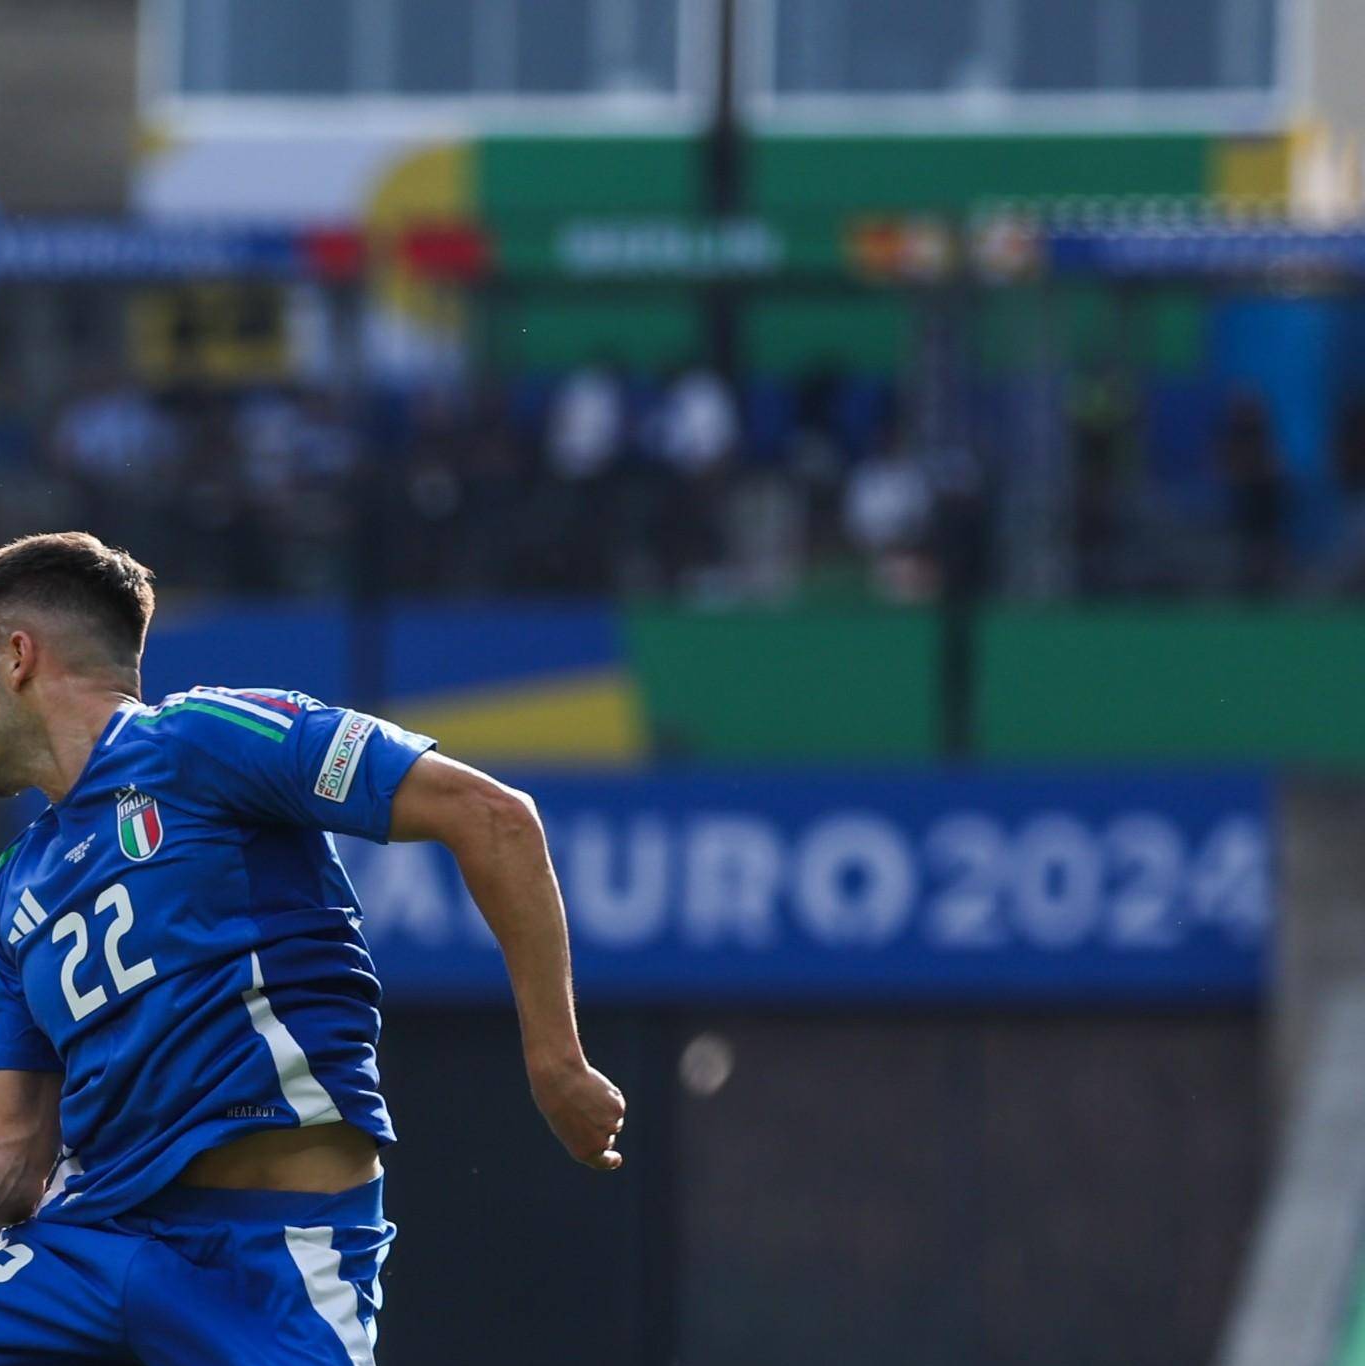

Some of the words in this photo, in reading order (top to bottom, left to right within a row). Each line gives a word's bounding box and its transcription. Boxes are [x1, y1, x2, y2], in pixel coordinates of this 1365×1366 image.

[566, 812, 919, 952] URO
[921, 812, 1273, 952] 2024
[52, 883, 157, 1022] 22
